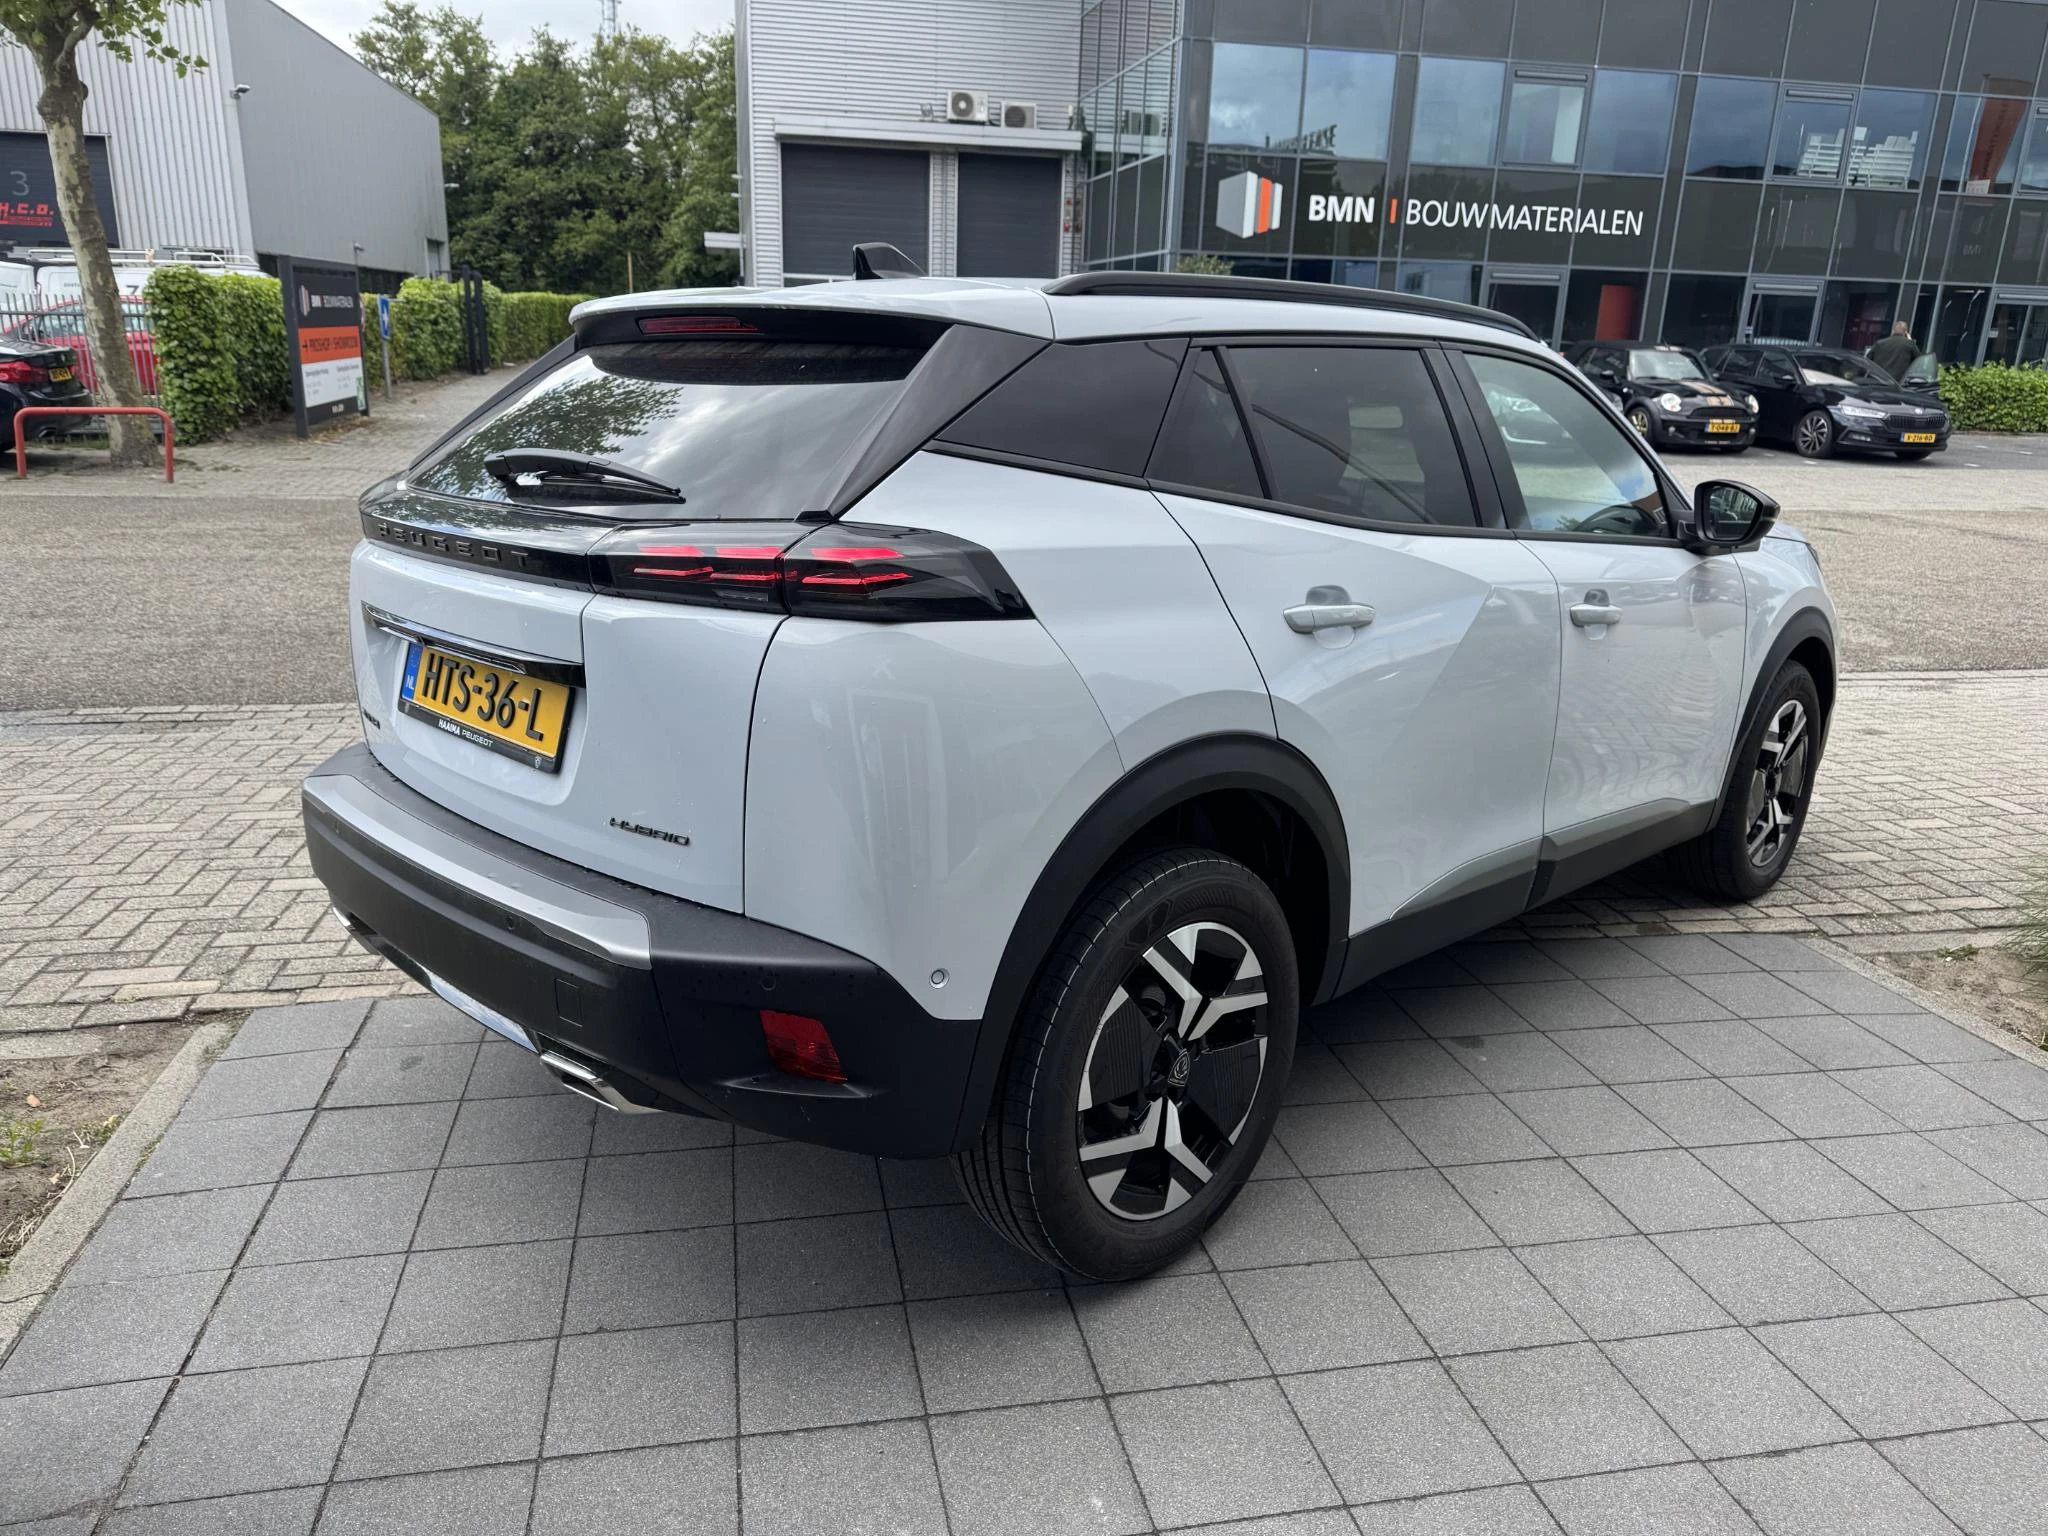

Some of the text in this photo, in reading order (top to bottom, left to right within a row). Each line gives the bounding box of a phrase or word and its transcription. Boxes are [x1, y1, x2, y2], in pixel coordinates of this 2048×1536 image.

[9, 170, 30, 197] 3
[1308, 194, 1644, 236] BMN BOUWMATERIALEN
[376, 522, 529, 568] PEUGEOT
[405, 675, 415, 690] NL
[421, 652, 544, 742] HTS-36-L
[461, 729, 494, 748] PEUGEOT
[609, 817, 691, 847] HYBRID
